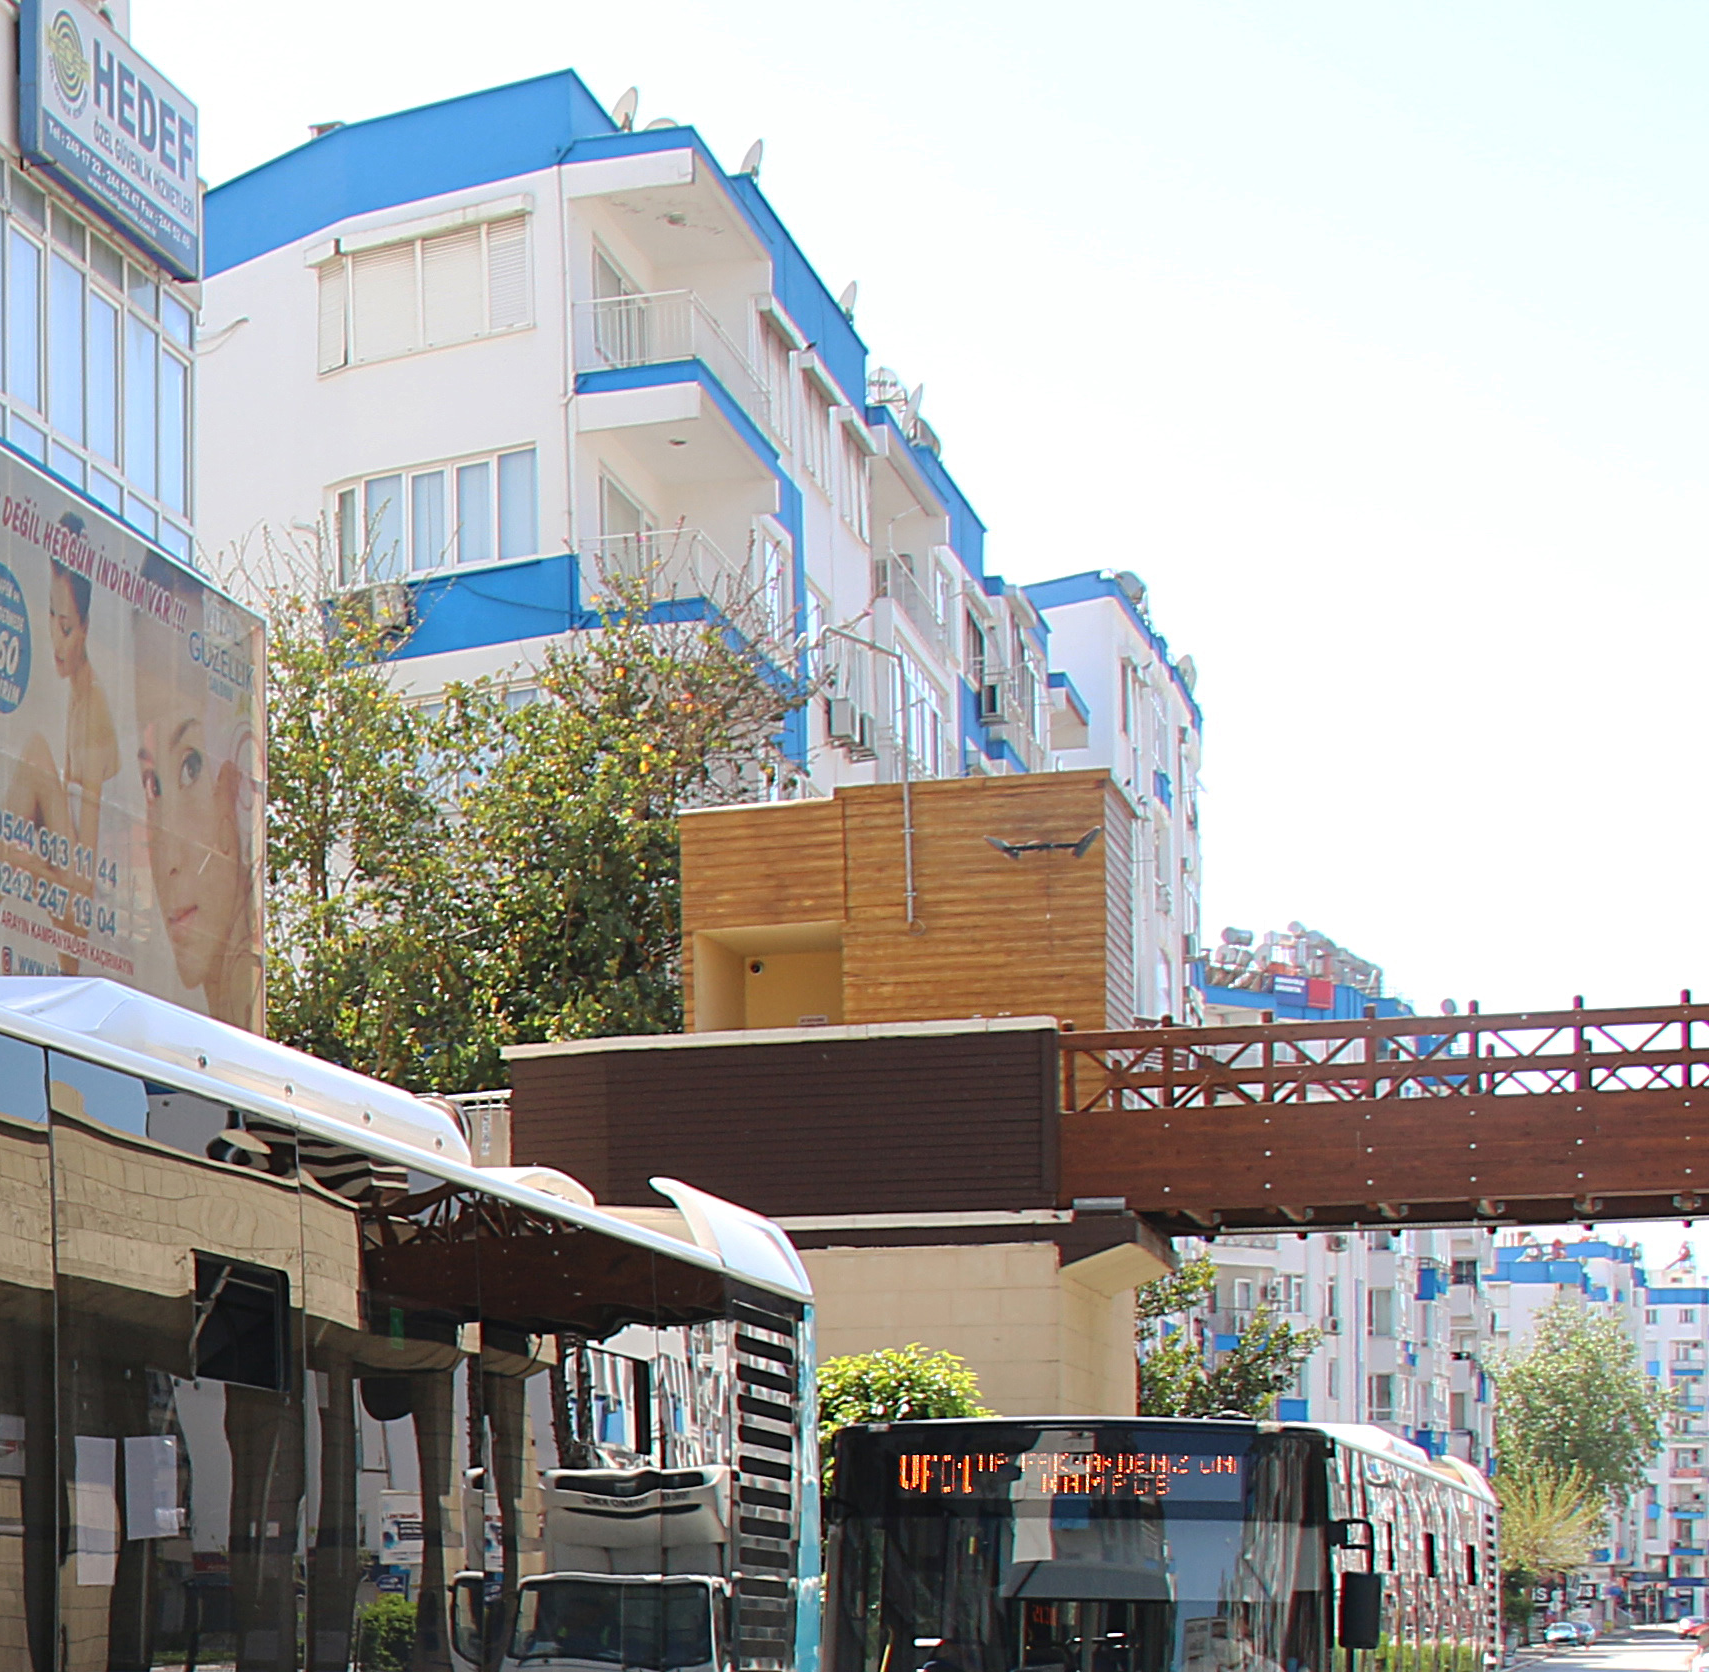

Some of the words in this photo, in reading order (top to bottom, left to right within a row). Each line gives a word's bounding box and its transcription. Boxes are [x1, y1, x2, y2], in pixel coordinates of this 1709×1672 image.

[93, 37, 194, 182] HEDEF
[2, 495, 40, 545] DEĞİL
[43, 523, 96, 579] HERGÜN
[97, 545, 145, 612] İNDİRİM
[147, 579, 171, 625] VAR
[39, 828, 69, 869] 613
[74, 845, 93, 880] 11
[98, 857, 118, 889] 44
[1, 908, 30, 935] ARAYIN
[38, 879, 68, 920] 247
[73, 895, 92, 928] 19
[97, 906, 117, 938] 04
